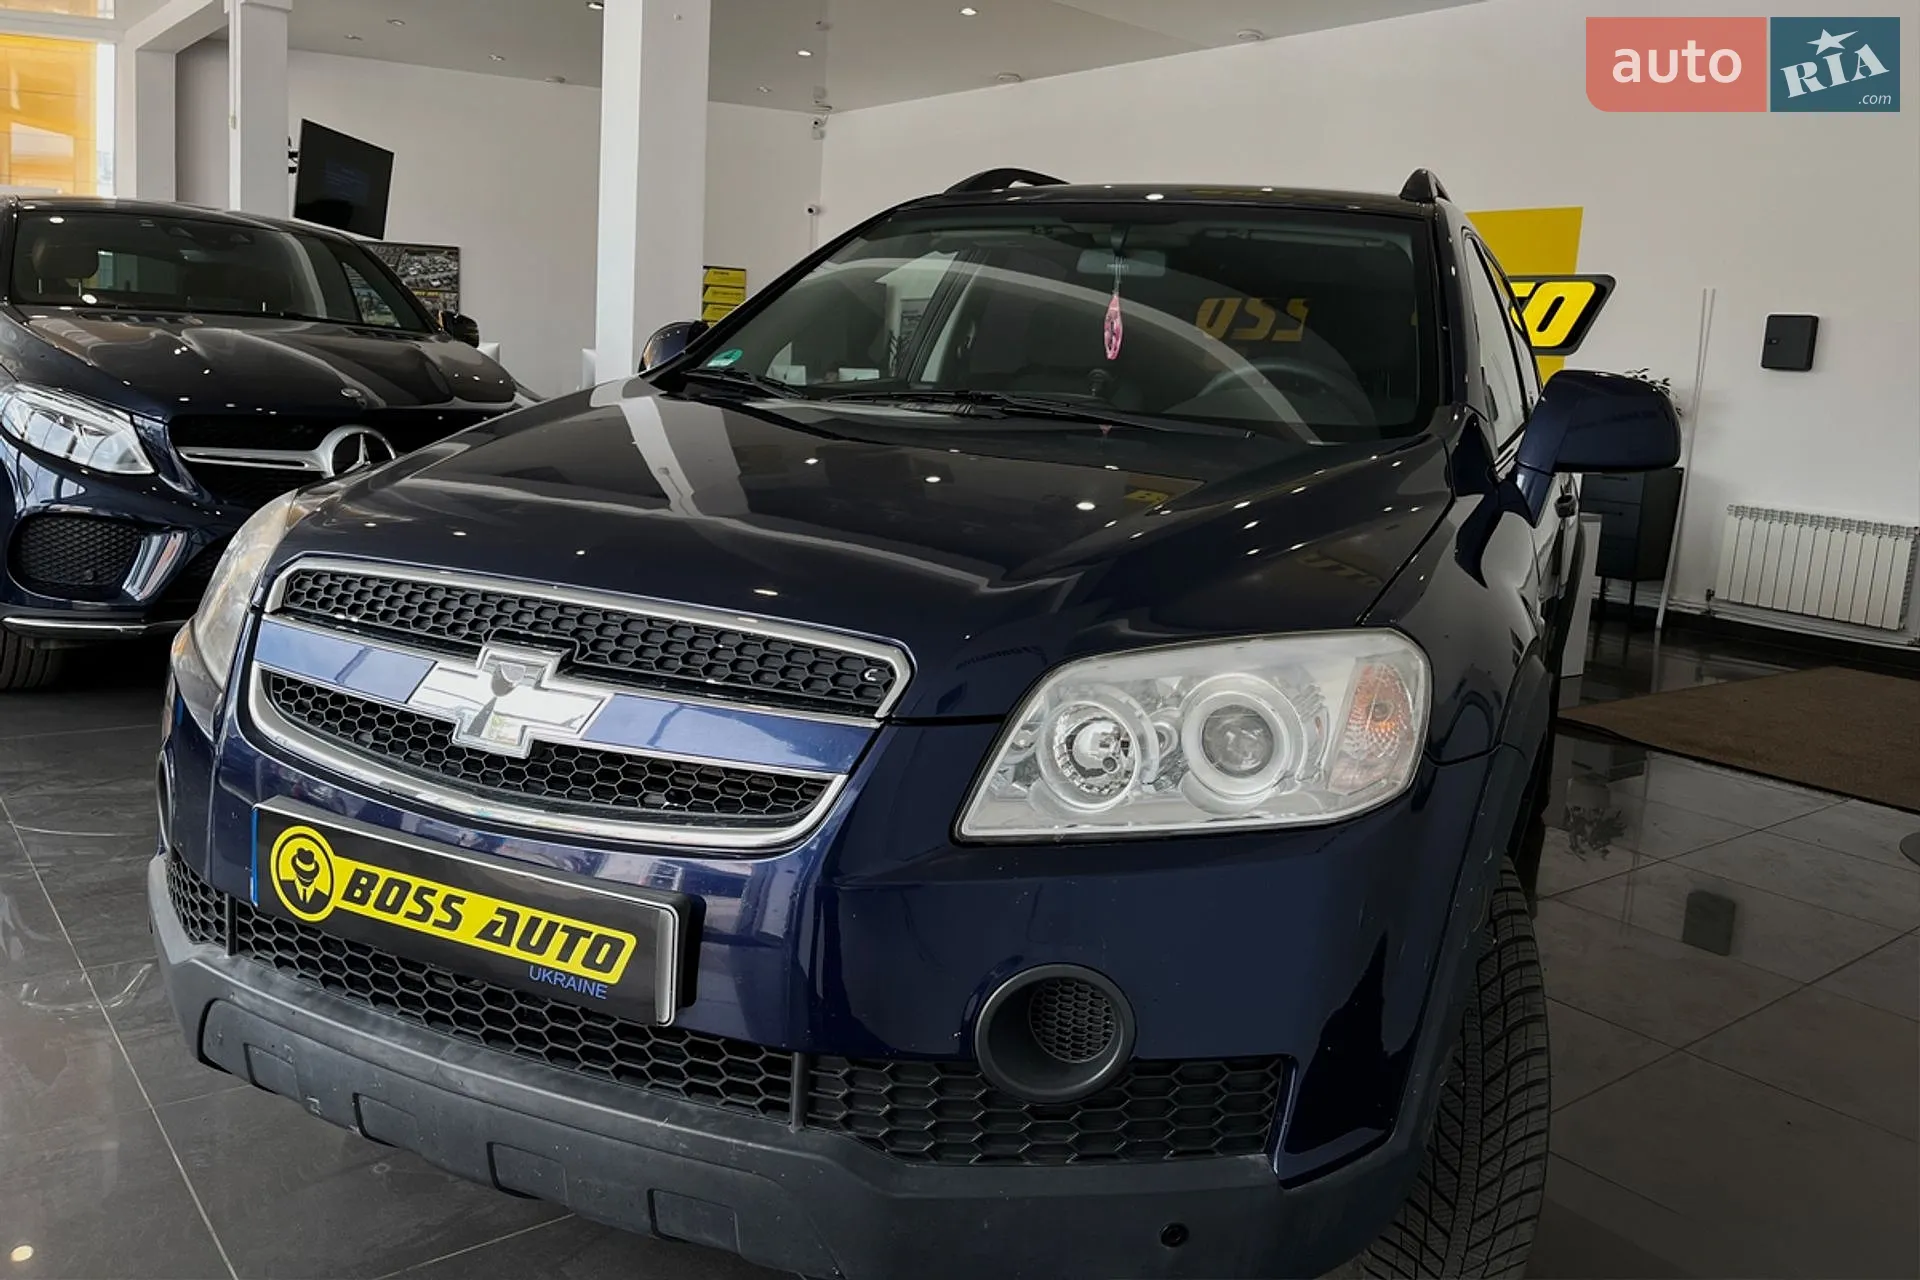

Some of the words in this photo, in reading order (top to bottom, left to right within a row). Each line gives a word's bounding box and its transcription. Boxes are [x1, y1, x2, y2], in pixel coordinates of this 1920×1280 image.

[341, 868, 467, 932] BOSS
[475, 906, 627, 973] AUTO
[529, 965, 608, 1000] UKRAINE
